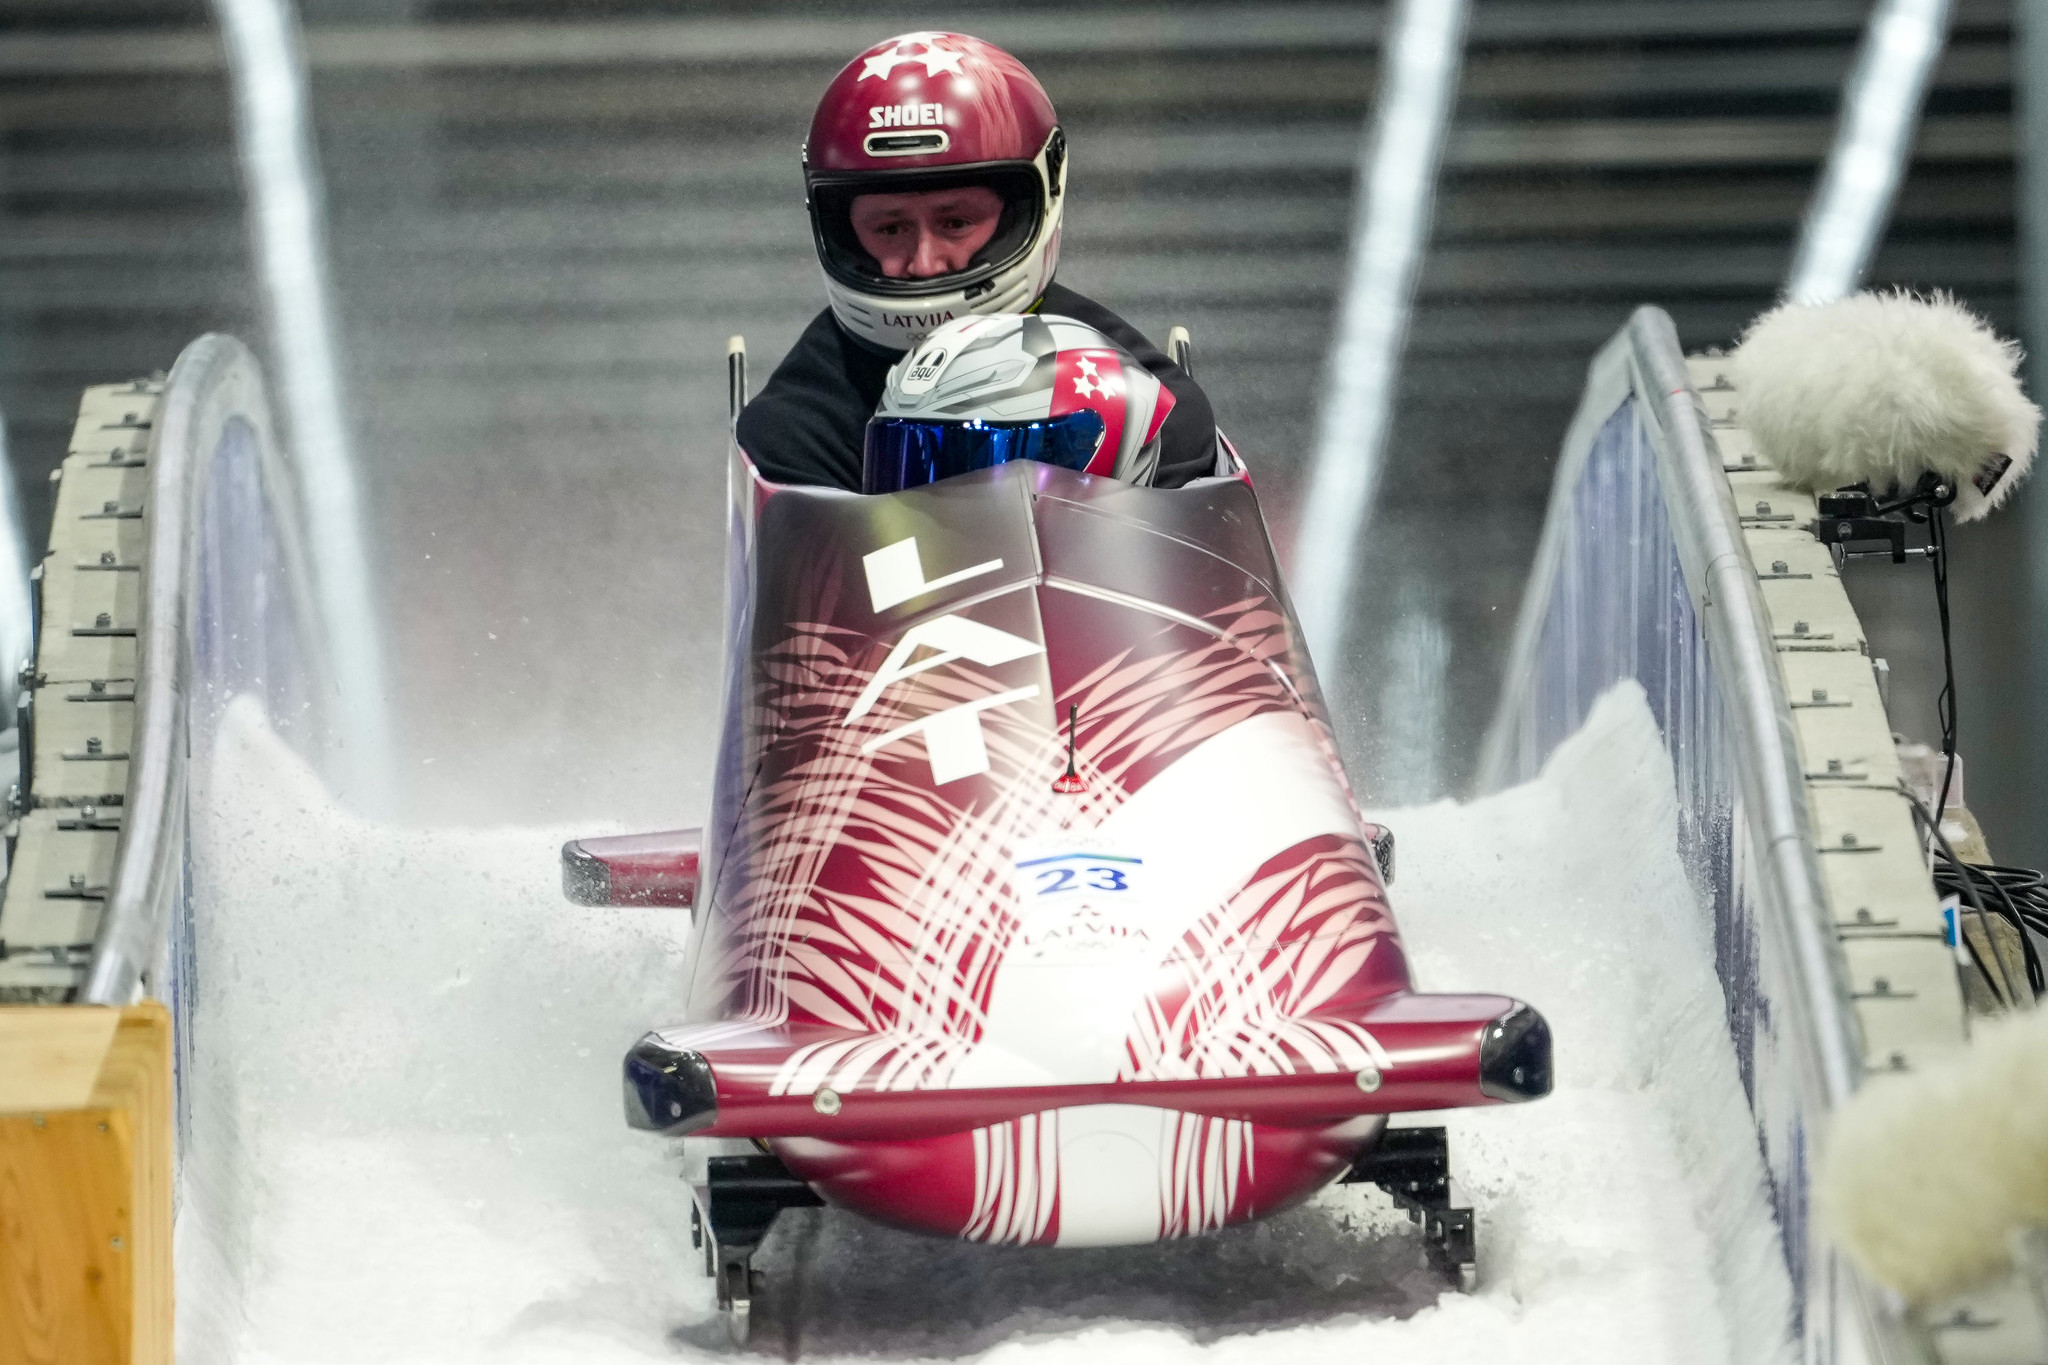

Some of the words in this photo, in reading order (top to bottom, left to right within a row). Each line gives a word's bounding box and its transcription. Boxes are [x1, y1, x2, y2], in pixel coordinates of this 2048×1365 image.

[868, 102, 944, 129] SHOEI
[882, 310, 954, 328] LATVIJA
[842, 536, 1047, 786] LAT
[1036, 867, 1129, 895] 23
